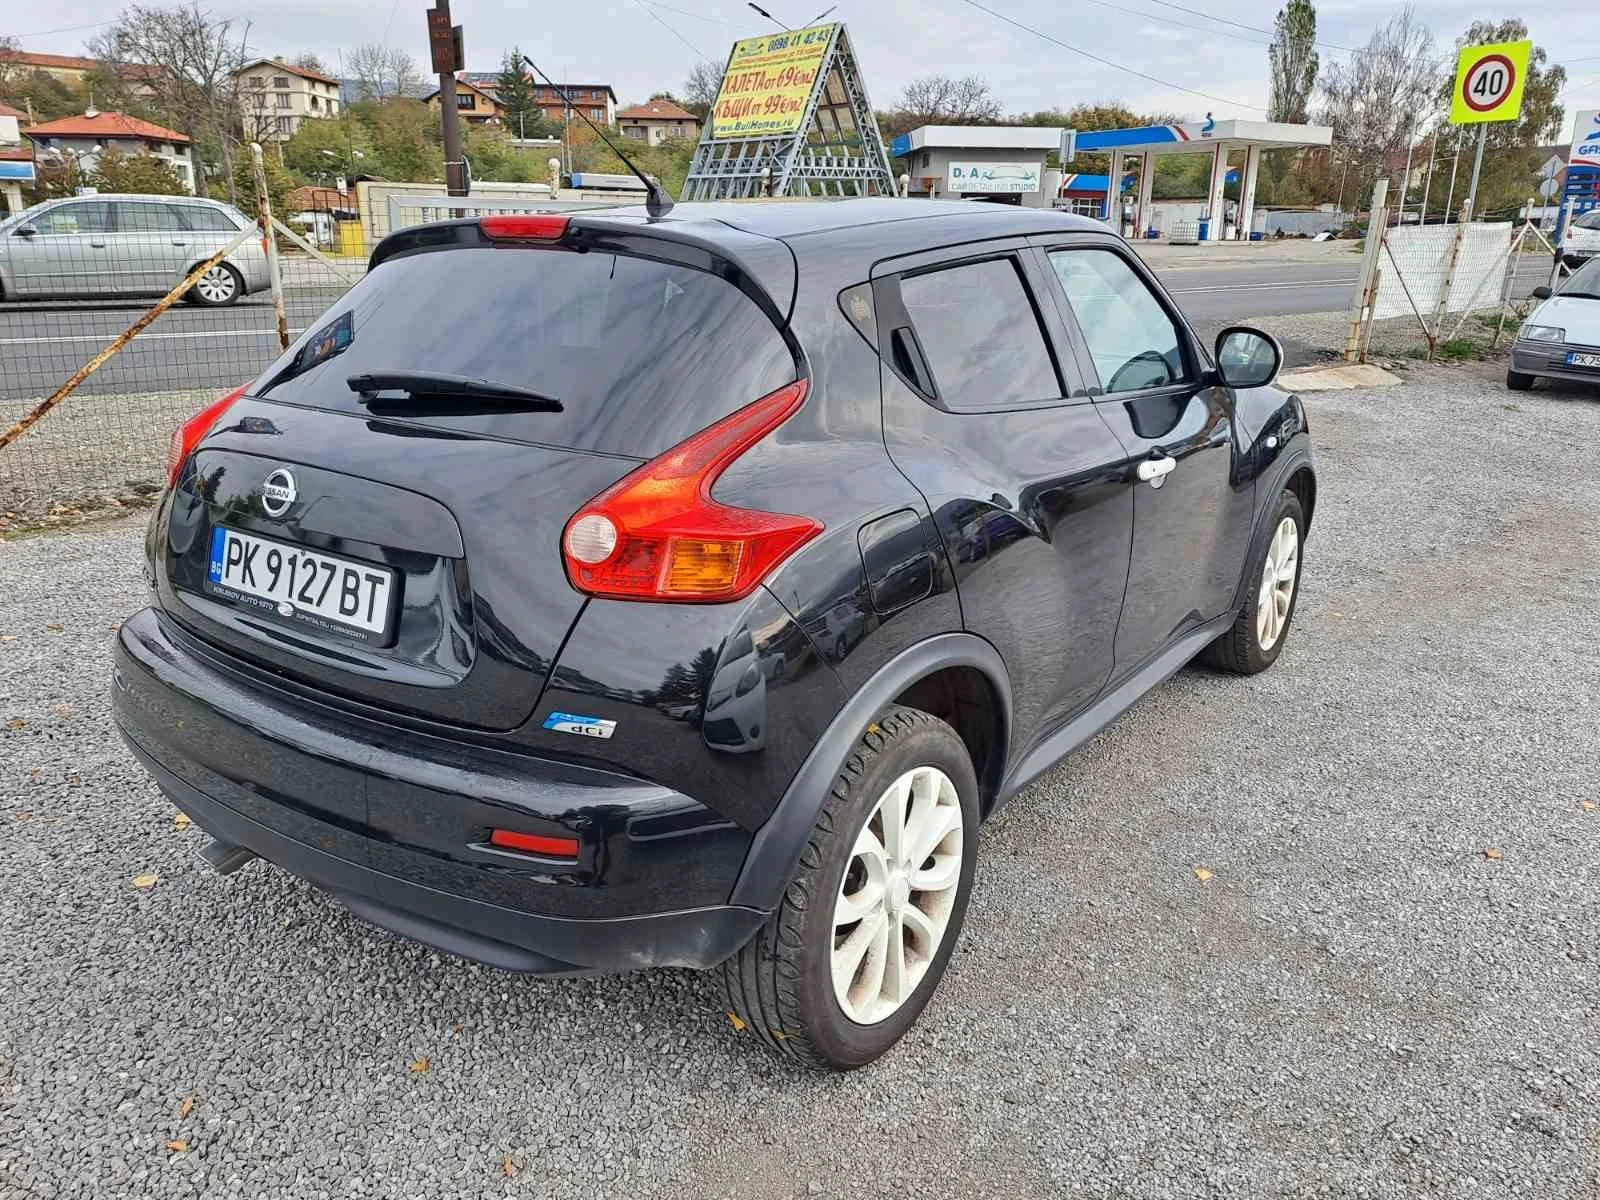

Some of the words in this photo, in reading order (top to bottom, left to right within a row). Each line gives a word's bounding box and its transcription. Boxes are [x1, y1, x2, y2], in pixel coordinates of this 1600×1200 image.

[1473, 69, 1503, 96] 40
[714, 97, 753, 120] КЪЩИ
[969, 167, 979, 178] A
[1010, 183, 1036, 191] STUDIO
[1575, 354, 1588, 365] PK
[210, 560, 222, 575] BG
[225, 537, 260, 588] PK
[266, 549, 337, 607] 9127
[339, 568, 385, 623] BT
[240, 594, 258, 606] AUTO
